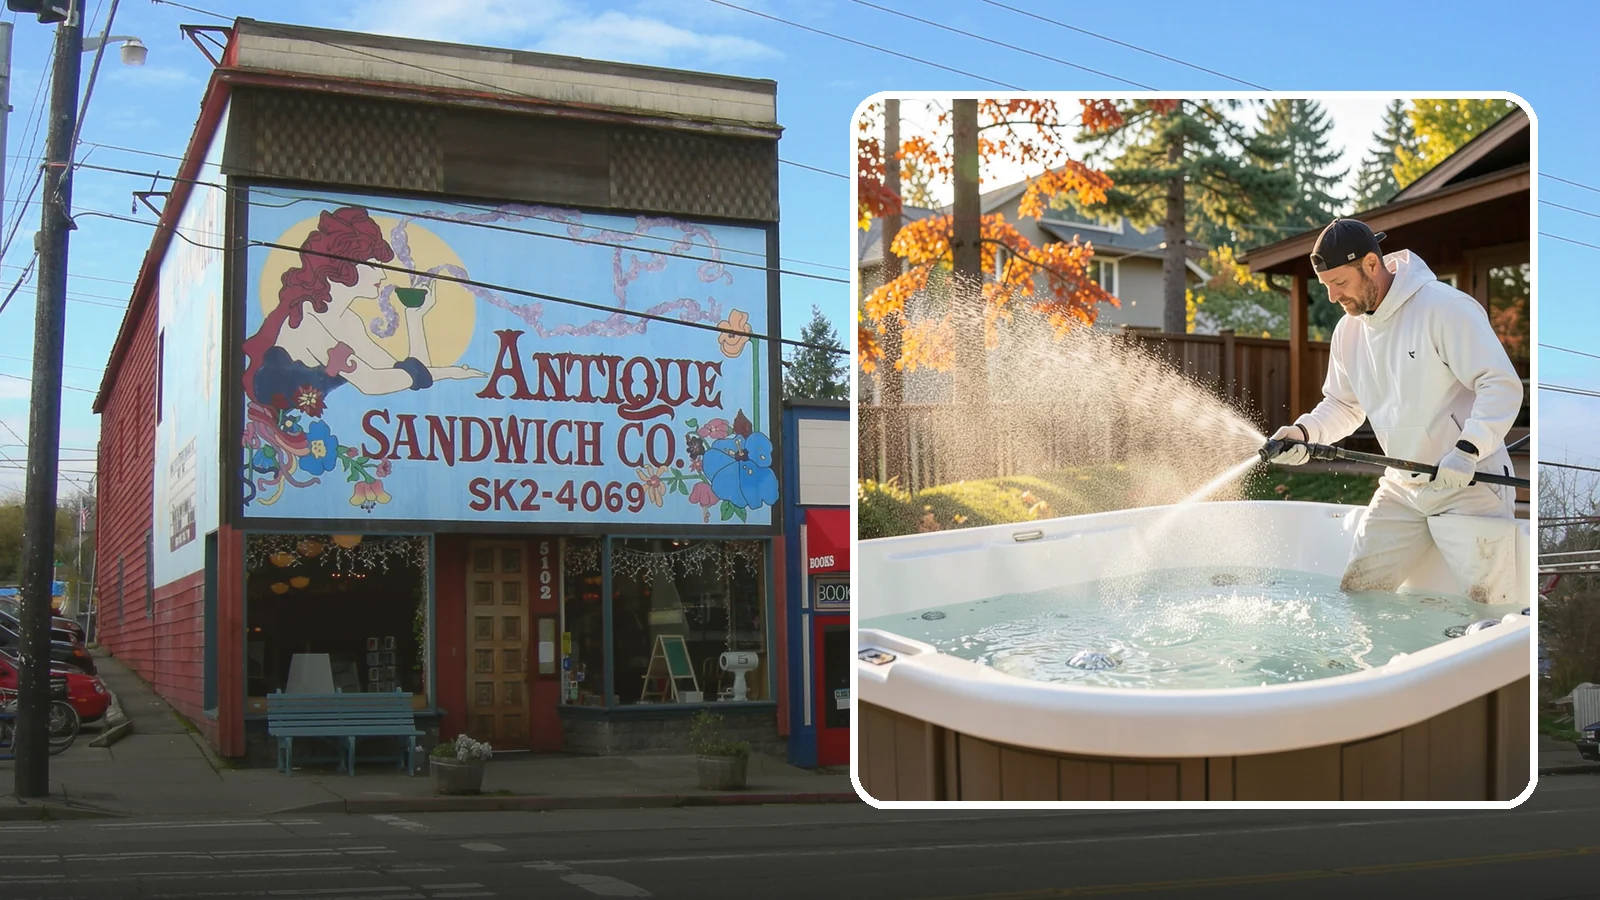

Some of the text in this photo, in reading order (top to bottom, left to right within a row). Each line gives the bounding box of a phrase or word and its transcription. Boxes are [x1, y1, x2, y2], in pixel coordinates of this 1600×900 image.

[476, 329, 723, 421] ANTIQUE
[361, 409, 685, 469] SANDWICH CO.
[468, 477, 645, 513] SK2-4069
[540, 542, 551, 599] 5102
[809, 555, 835, 569] BOOKS
